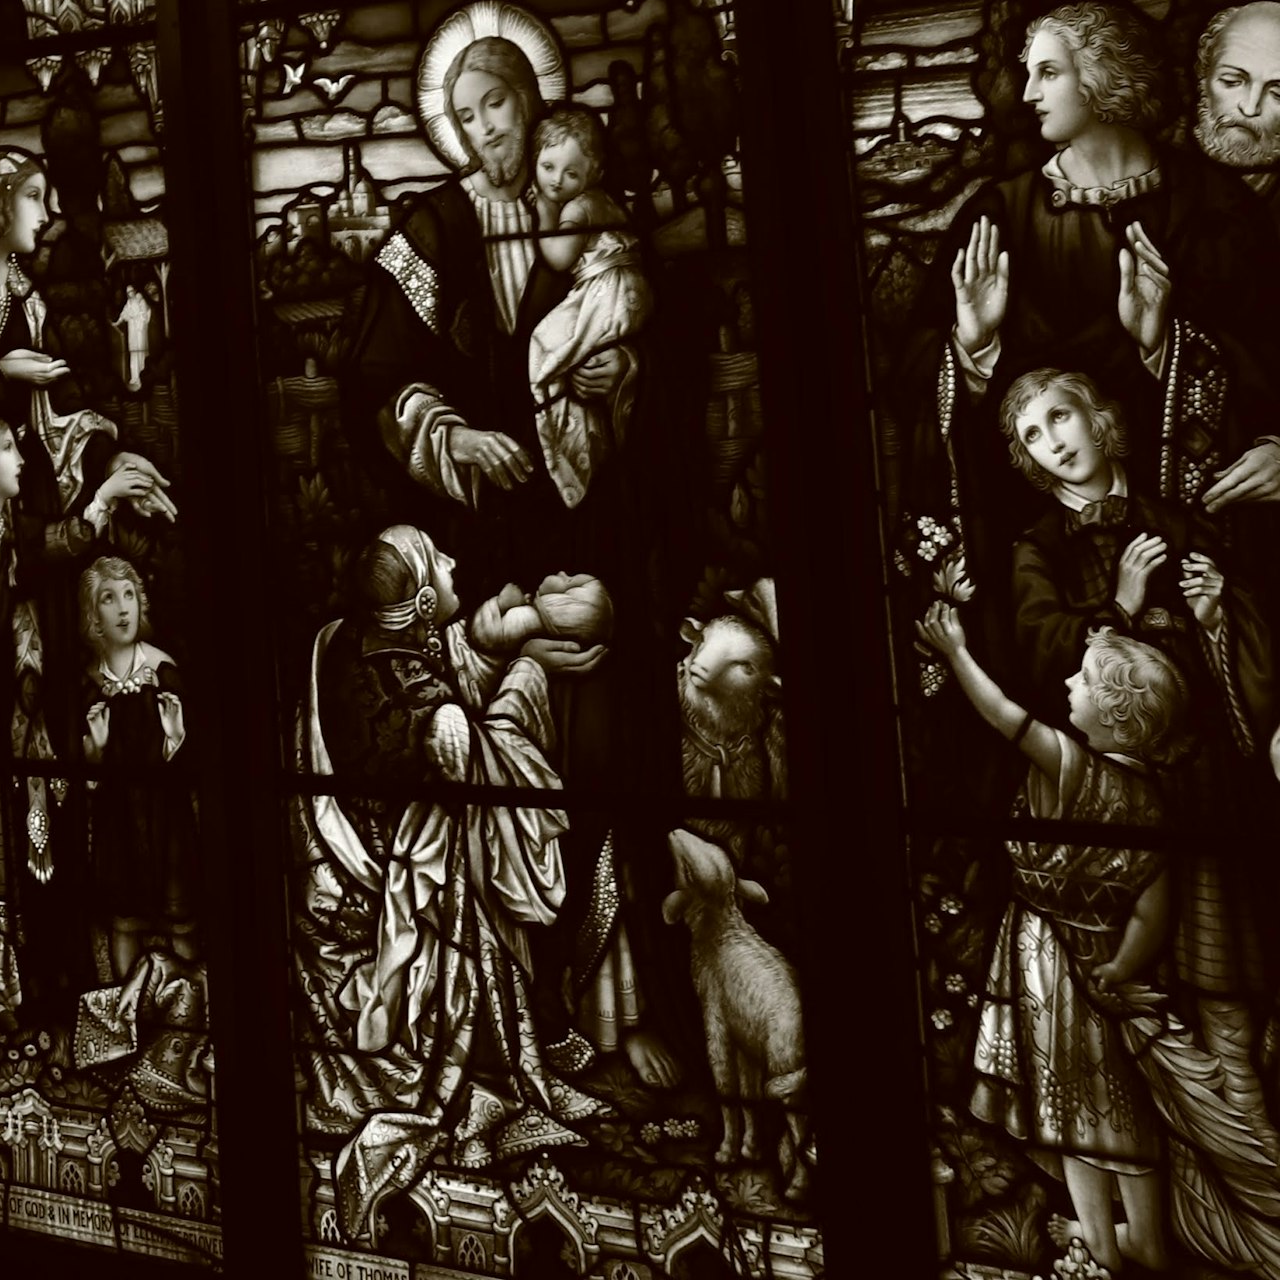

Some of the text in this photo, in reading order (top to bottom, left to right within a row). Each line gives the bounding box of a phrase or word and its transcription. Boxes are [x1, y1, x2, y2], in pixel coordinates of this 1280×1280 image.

[9, 1197, 22, 1214] OF
[25, 1201, 45, 1219] GOD
[48, 1206, 55, 1220] &
[58, 1207, 69, 1224] IN
[73, 1209, 112, 1233] MEMORY
[306, 1254, 408, 1280] WIFE OF THOM
